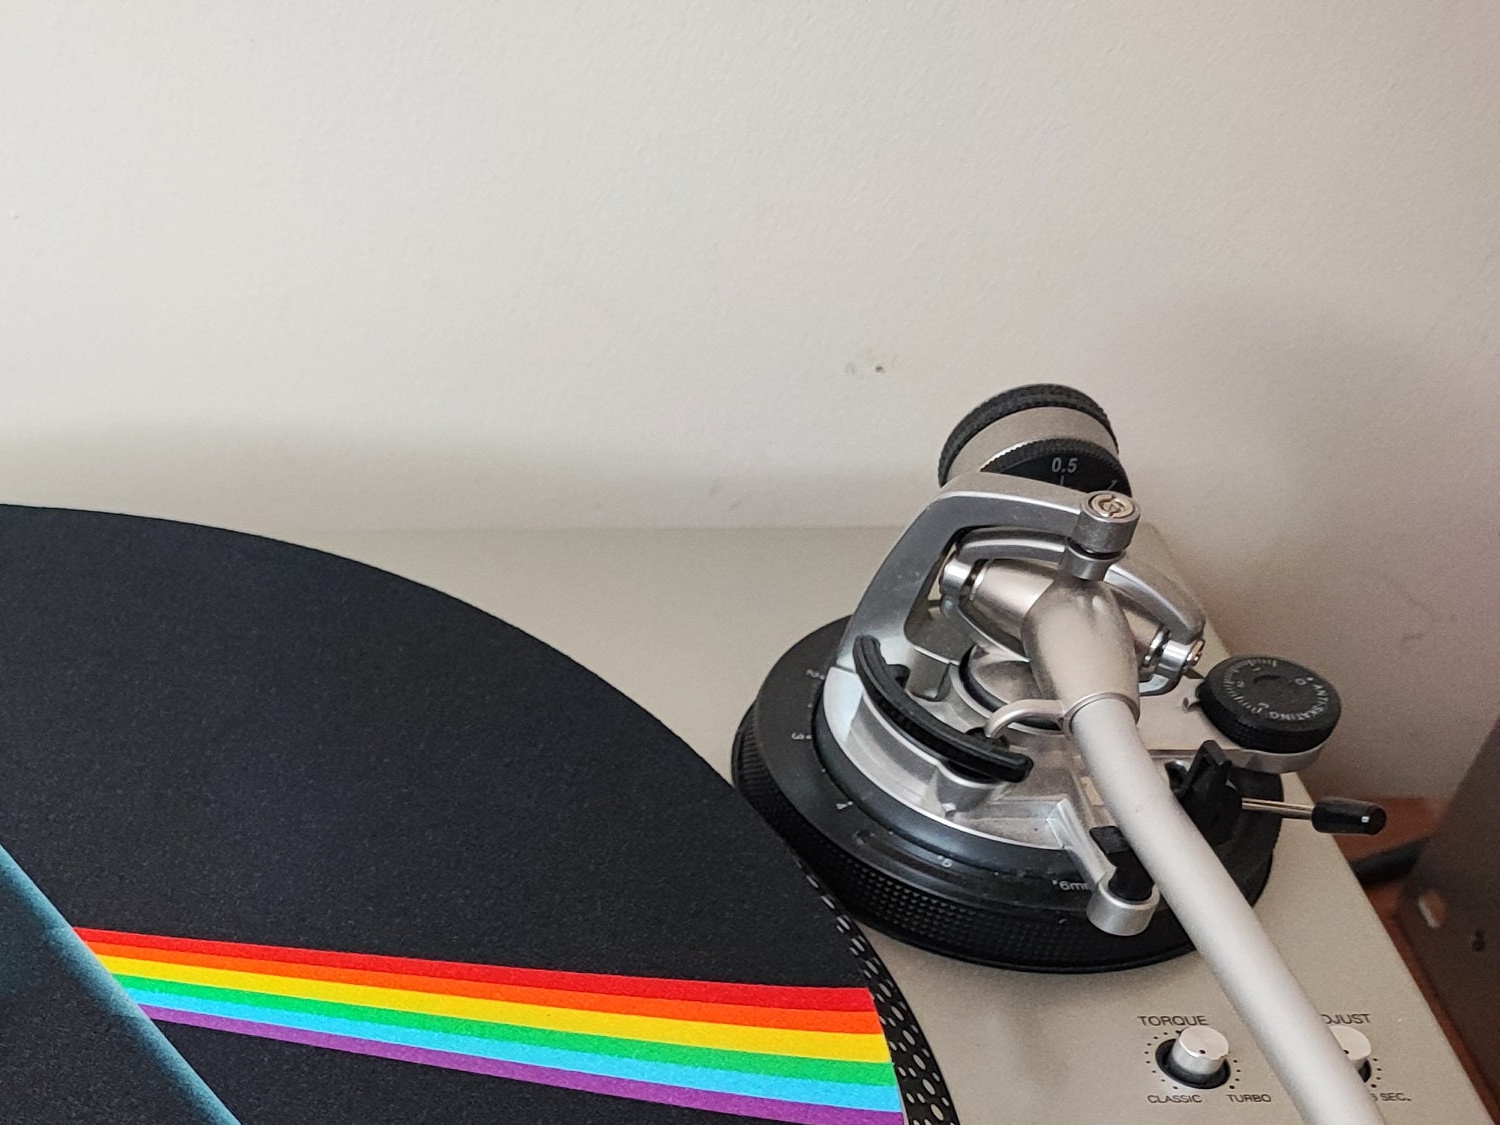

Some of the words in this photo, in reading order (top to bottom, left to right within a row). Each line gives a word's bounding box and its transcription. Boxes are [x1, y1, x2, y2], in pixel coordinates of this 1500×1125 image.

[1051, 457, 1078, 474] 0.5
[1137, 1015, 1210, 1027] TORQUE
[1320, 1013, 1372, 1025] DJUST
[1147, 1094, 1203, 1104] CLASSIC
[1226, 1093, 1272, 1103] TURBO
